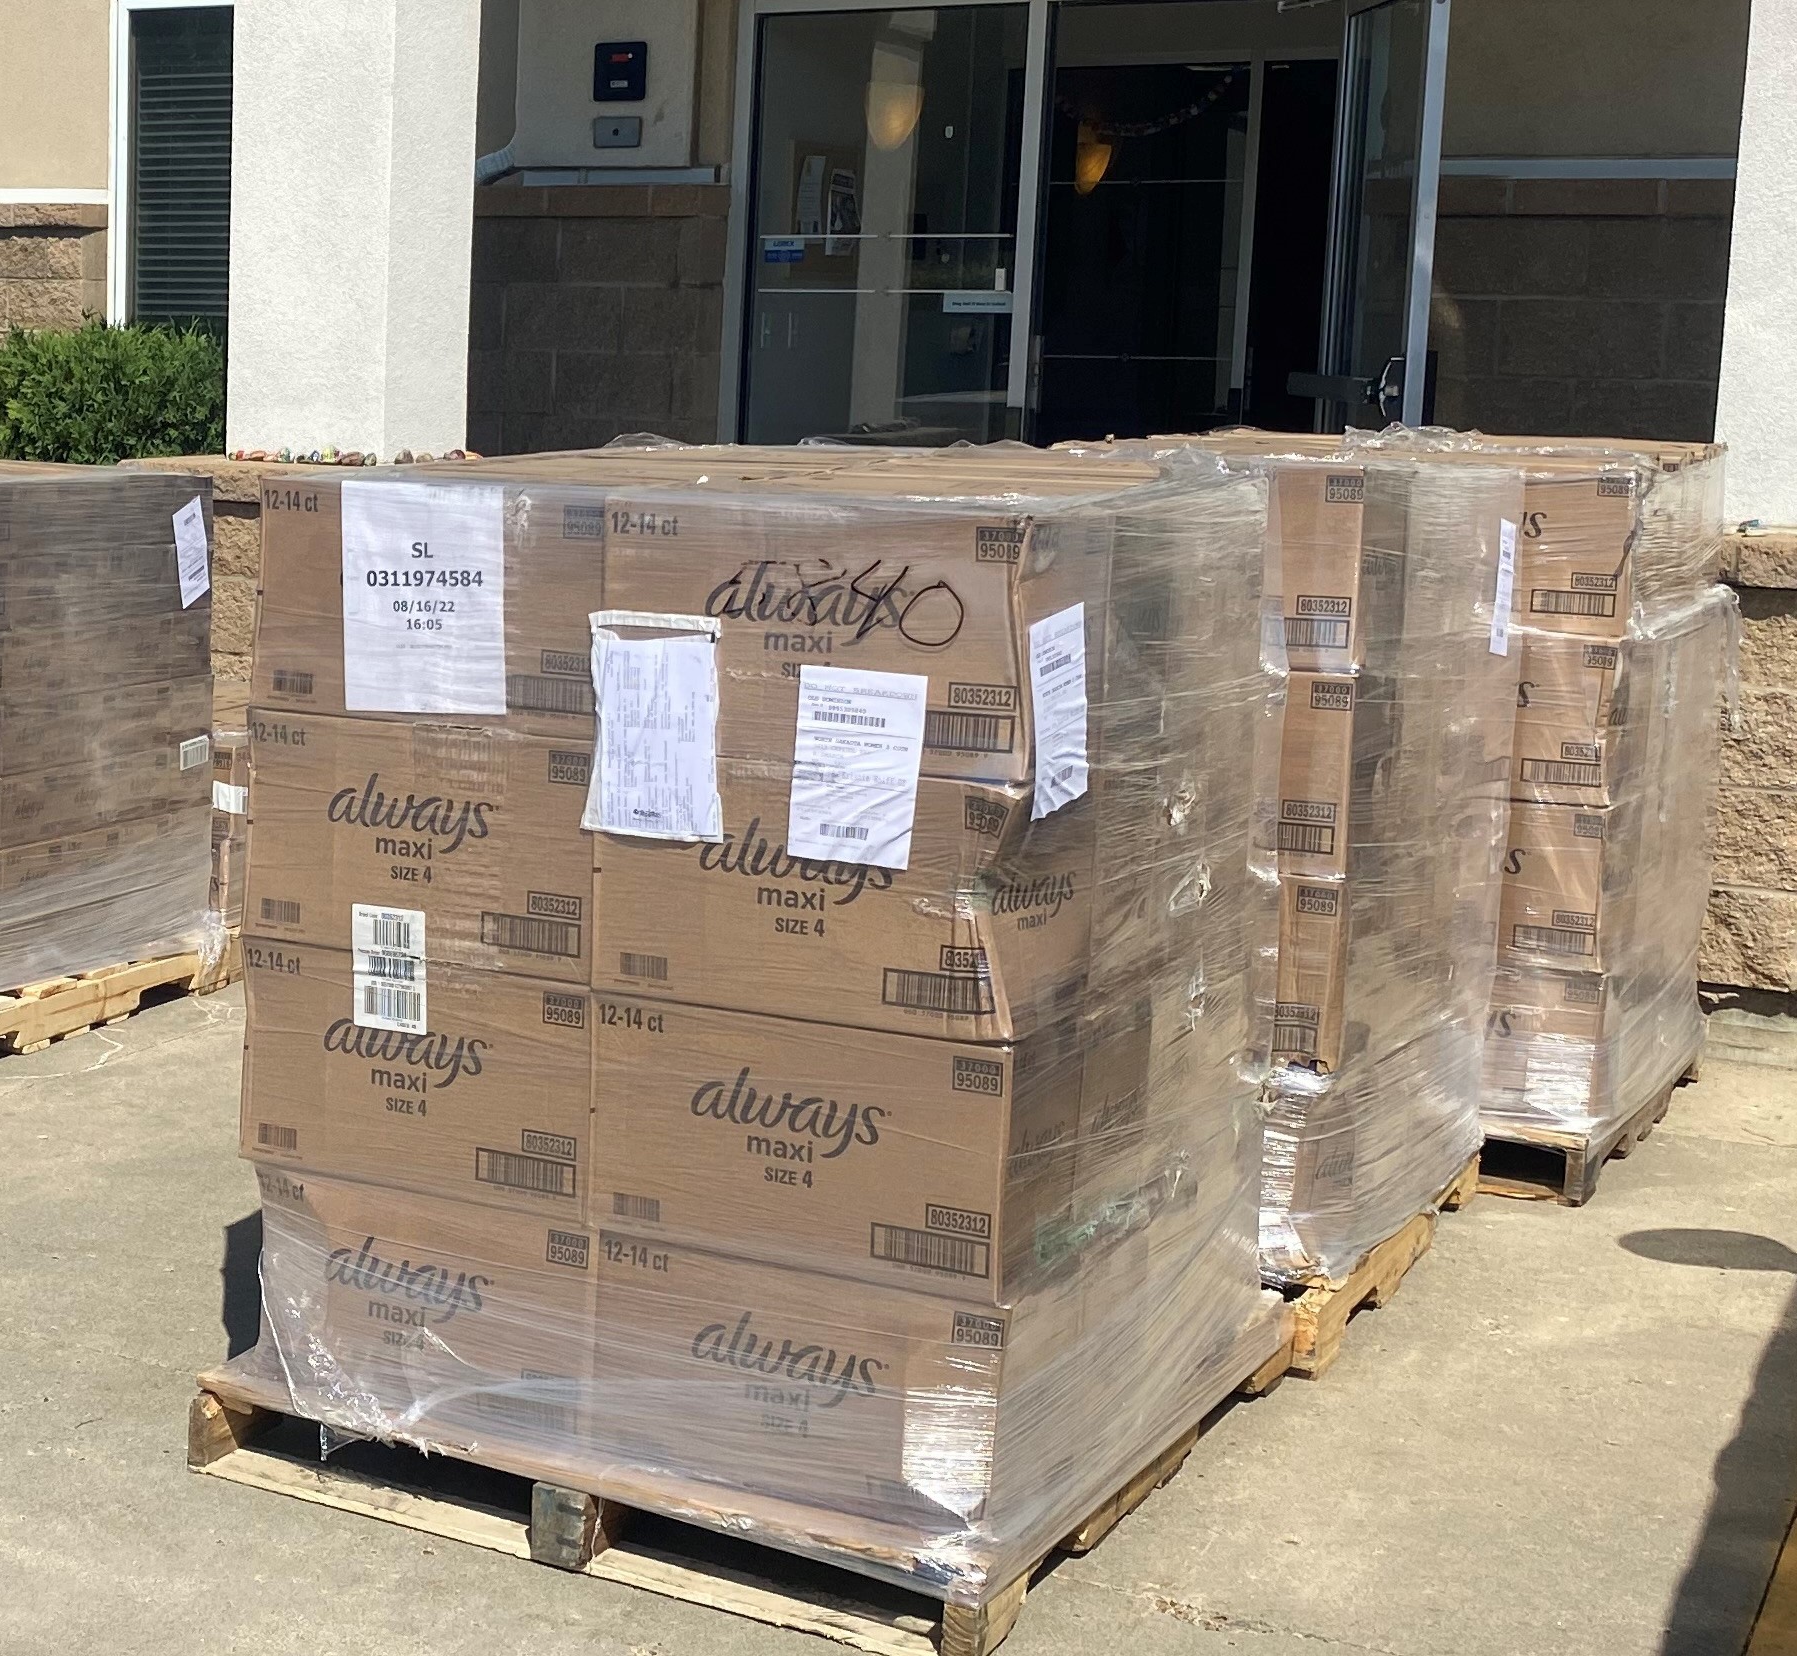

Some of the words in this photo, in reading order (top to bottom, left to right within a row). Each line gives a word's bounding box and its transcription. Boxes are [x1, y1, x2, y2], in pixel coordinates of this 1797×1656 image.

[265, 489, 302, 511] 12-14
[305, 493, 319, 513] ct
[1329, 487, 1364, 501] 95089
[612, 511, 656, 534] 12-14
[661, 516, 679, 536] ct
[411, 542, 434, 559] SL
[980, 542, 1021, 560] 95089
[366, 570, 484, 587] 0311974584
[392, 600, 455, 613] 08/16/22
[705, 561, 915, 647] always
[1300, 598, 1348, 615] 80352312
[406, 619, 443, 631] 16:05
[764, 631, 833, 653] maxi
[954, 687, 1012, 707] 80352312
[1314, 694, 1350, 708] 95089
[252, 722, 287, 745] 12-14
[291, 727, 306, 746] ct
[551, 766, 587, 783] 95089
[327, 773, 496, 854] always
[1286, 804, 1333, 819] 80352312
[375, 837, 433, 860] maxi
[698, 817, 893, 906] always
[390, 865, 419, 882] SIZE
[423, 867, 433, 884] 4
[531, 895, 578, 915] 80352312
[757, 886, 825, 911] maxi
[992, 872, 1076, 917] always
[1299, 899, 1335, 913] 95089
[775, 917, 808, 935] SIZE
[813, 918, 826, 937] 4
[1017, 914, 1047, 931] maxi
[247, 948, 284, 972] 12-14
[286, 955, 301, 975] ct
[546, 1006, 581, 1025] 95089
[599, 1004, 643, 1029] 12-14
[647, 1013, 664, 1034] ct
[323, 1018, 491, 1089] always
[960, 1060, 996, 1074] 37000
[371, 1067, 427, 1093] maxi
[956, 1073, 998, 1092] 95089
[385, 1097, 414, 1115] SIZE
[417, 1099, 427, 1116] 4
[690, 1066, 890, 1159] always
[525, 1132, 573, 1155] 80352312
[747, 1134, 813, 1164] maxi
[764, 1166, 797, 1185] SIZE
[802, 1169, 813, 1188] 4
[930, 1208, 986, 1234] 80352312
[550, 1243, 585, 1266] 95089
[605, 1239, 648, 1268] 12-14
[652, 1252, 669, 1273] ct
[326, 1237, 492, 1323] always
[368, 1299, 426, 1328] maxi
[956, 1328, 999, 1346] 95089
[692, 1311, 887, 1409] always
